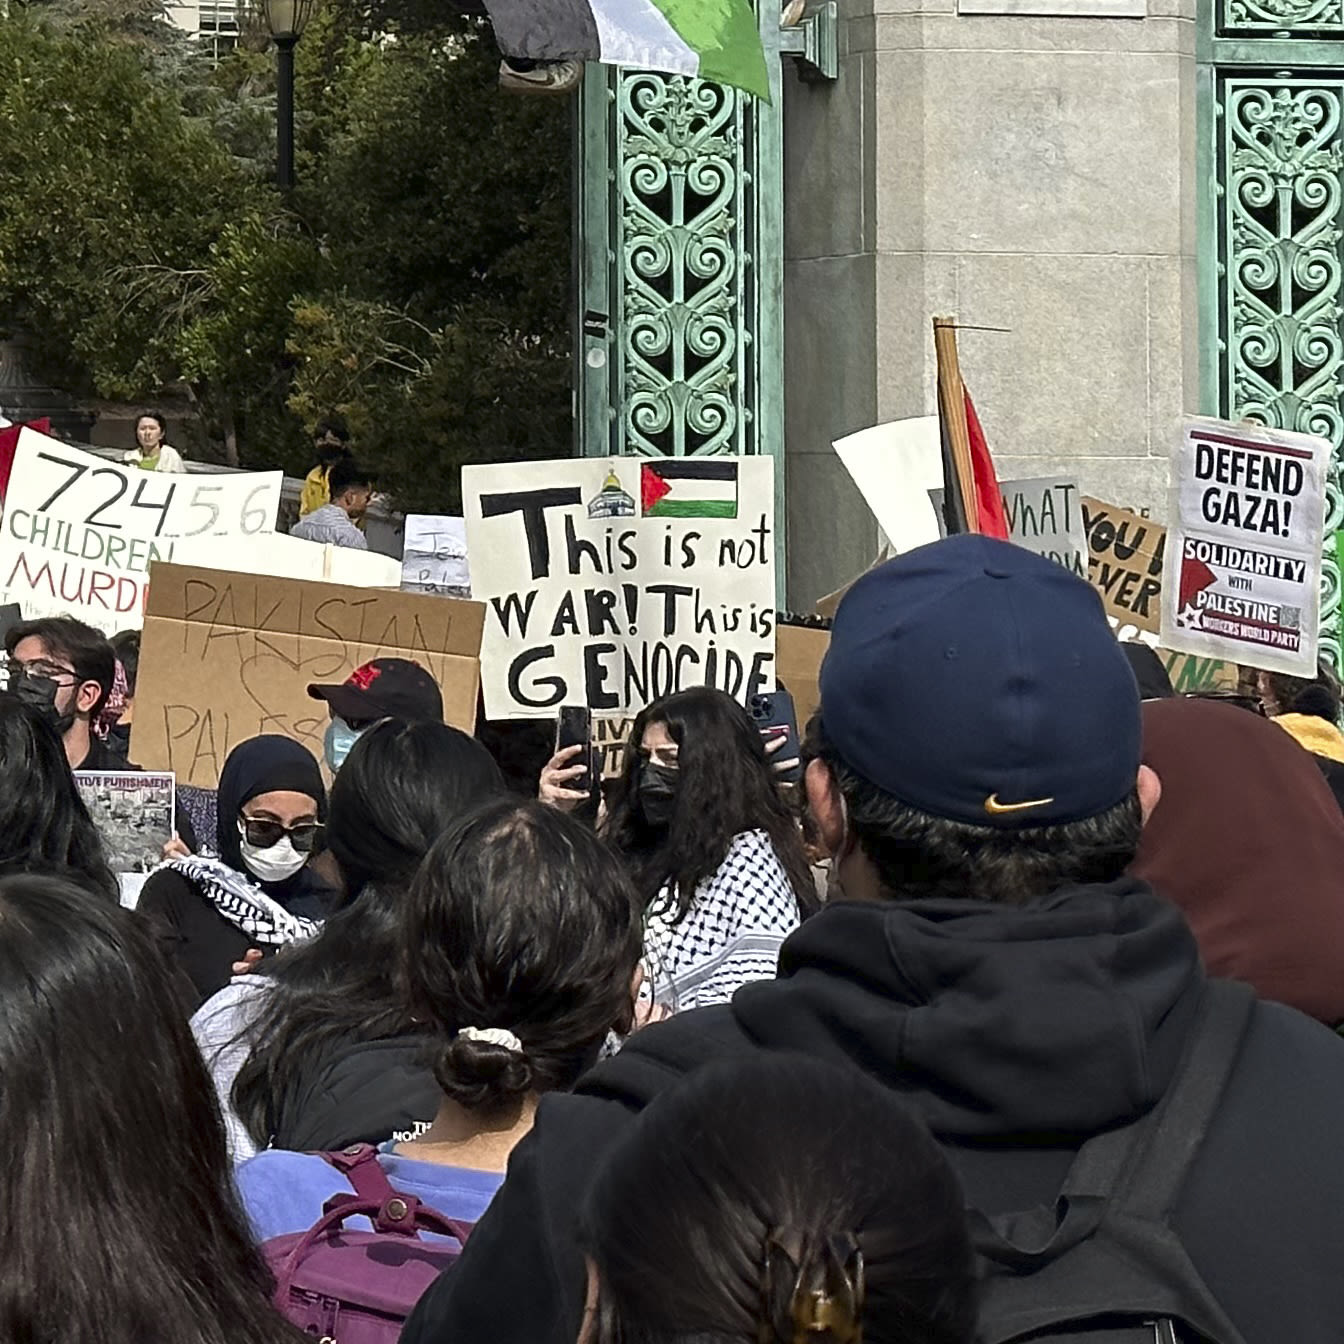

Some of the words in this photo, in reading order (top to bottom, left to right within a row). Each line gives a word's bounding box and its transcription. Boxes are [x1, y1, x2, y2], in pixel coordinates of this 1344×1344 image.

[1194, 443, 1305, 498] DEFEND
[480, 486, 638, 580] This
[664, 524, 702, 569] is
[718, 513, 772, 569] not
[1081, 504, 1147, 560] YOU
[1202, 487, 1293, 538] GAZA!
[1184, 538, 1306, 583] SOLIDARITY
[1226, 574, 1253, 592] WITH
[490, 583, 639, 640] WAR!
[645, 584, 742, 638] This
[748, 602, 775, 638] is
[1196, 589, 1279, 624] PALESTINE
[1202, 614, 1241, 636] WORKERS
[1240, 622, 1270, 643] WORLD
[1270, 629, 1300, 649] PARTY
